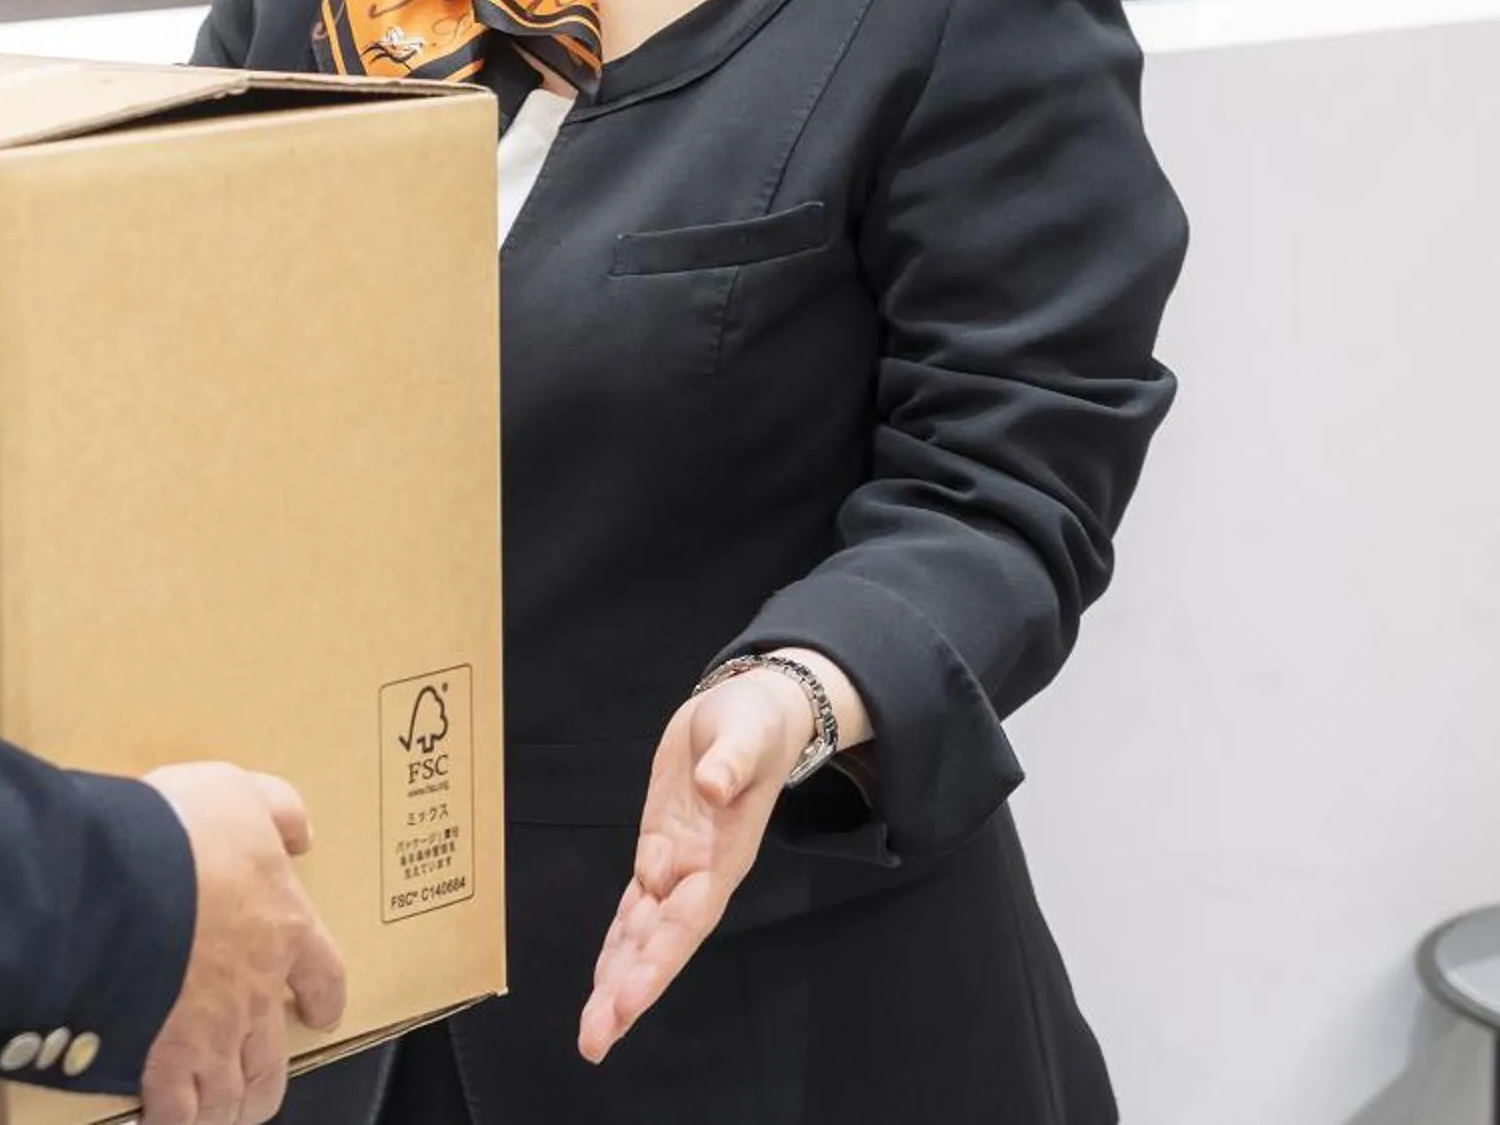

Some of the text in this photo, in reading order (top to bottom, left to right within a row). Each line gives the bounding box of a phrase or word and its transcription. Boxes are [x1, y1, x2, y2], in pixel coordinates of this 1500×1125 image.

[408, 754, 449, 784] FSC
[407, 803, 449, 826] ミックス
